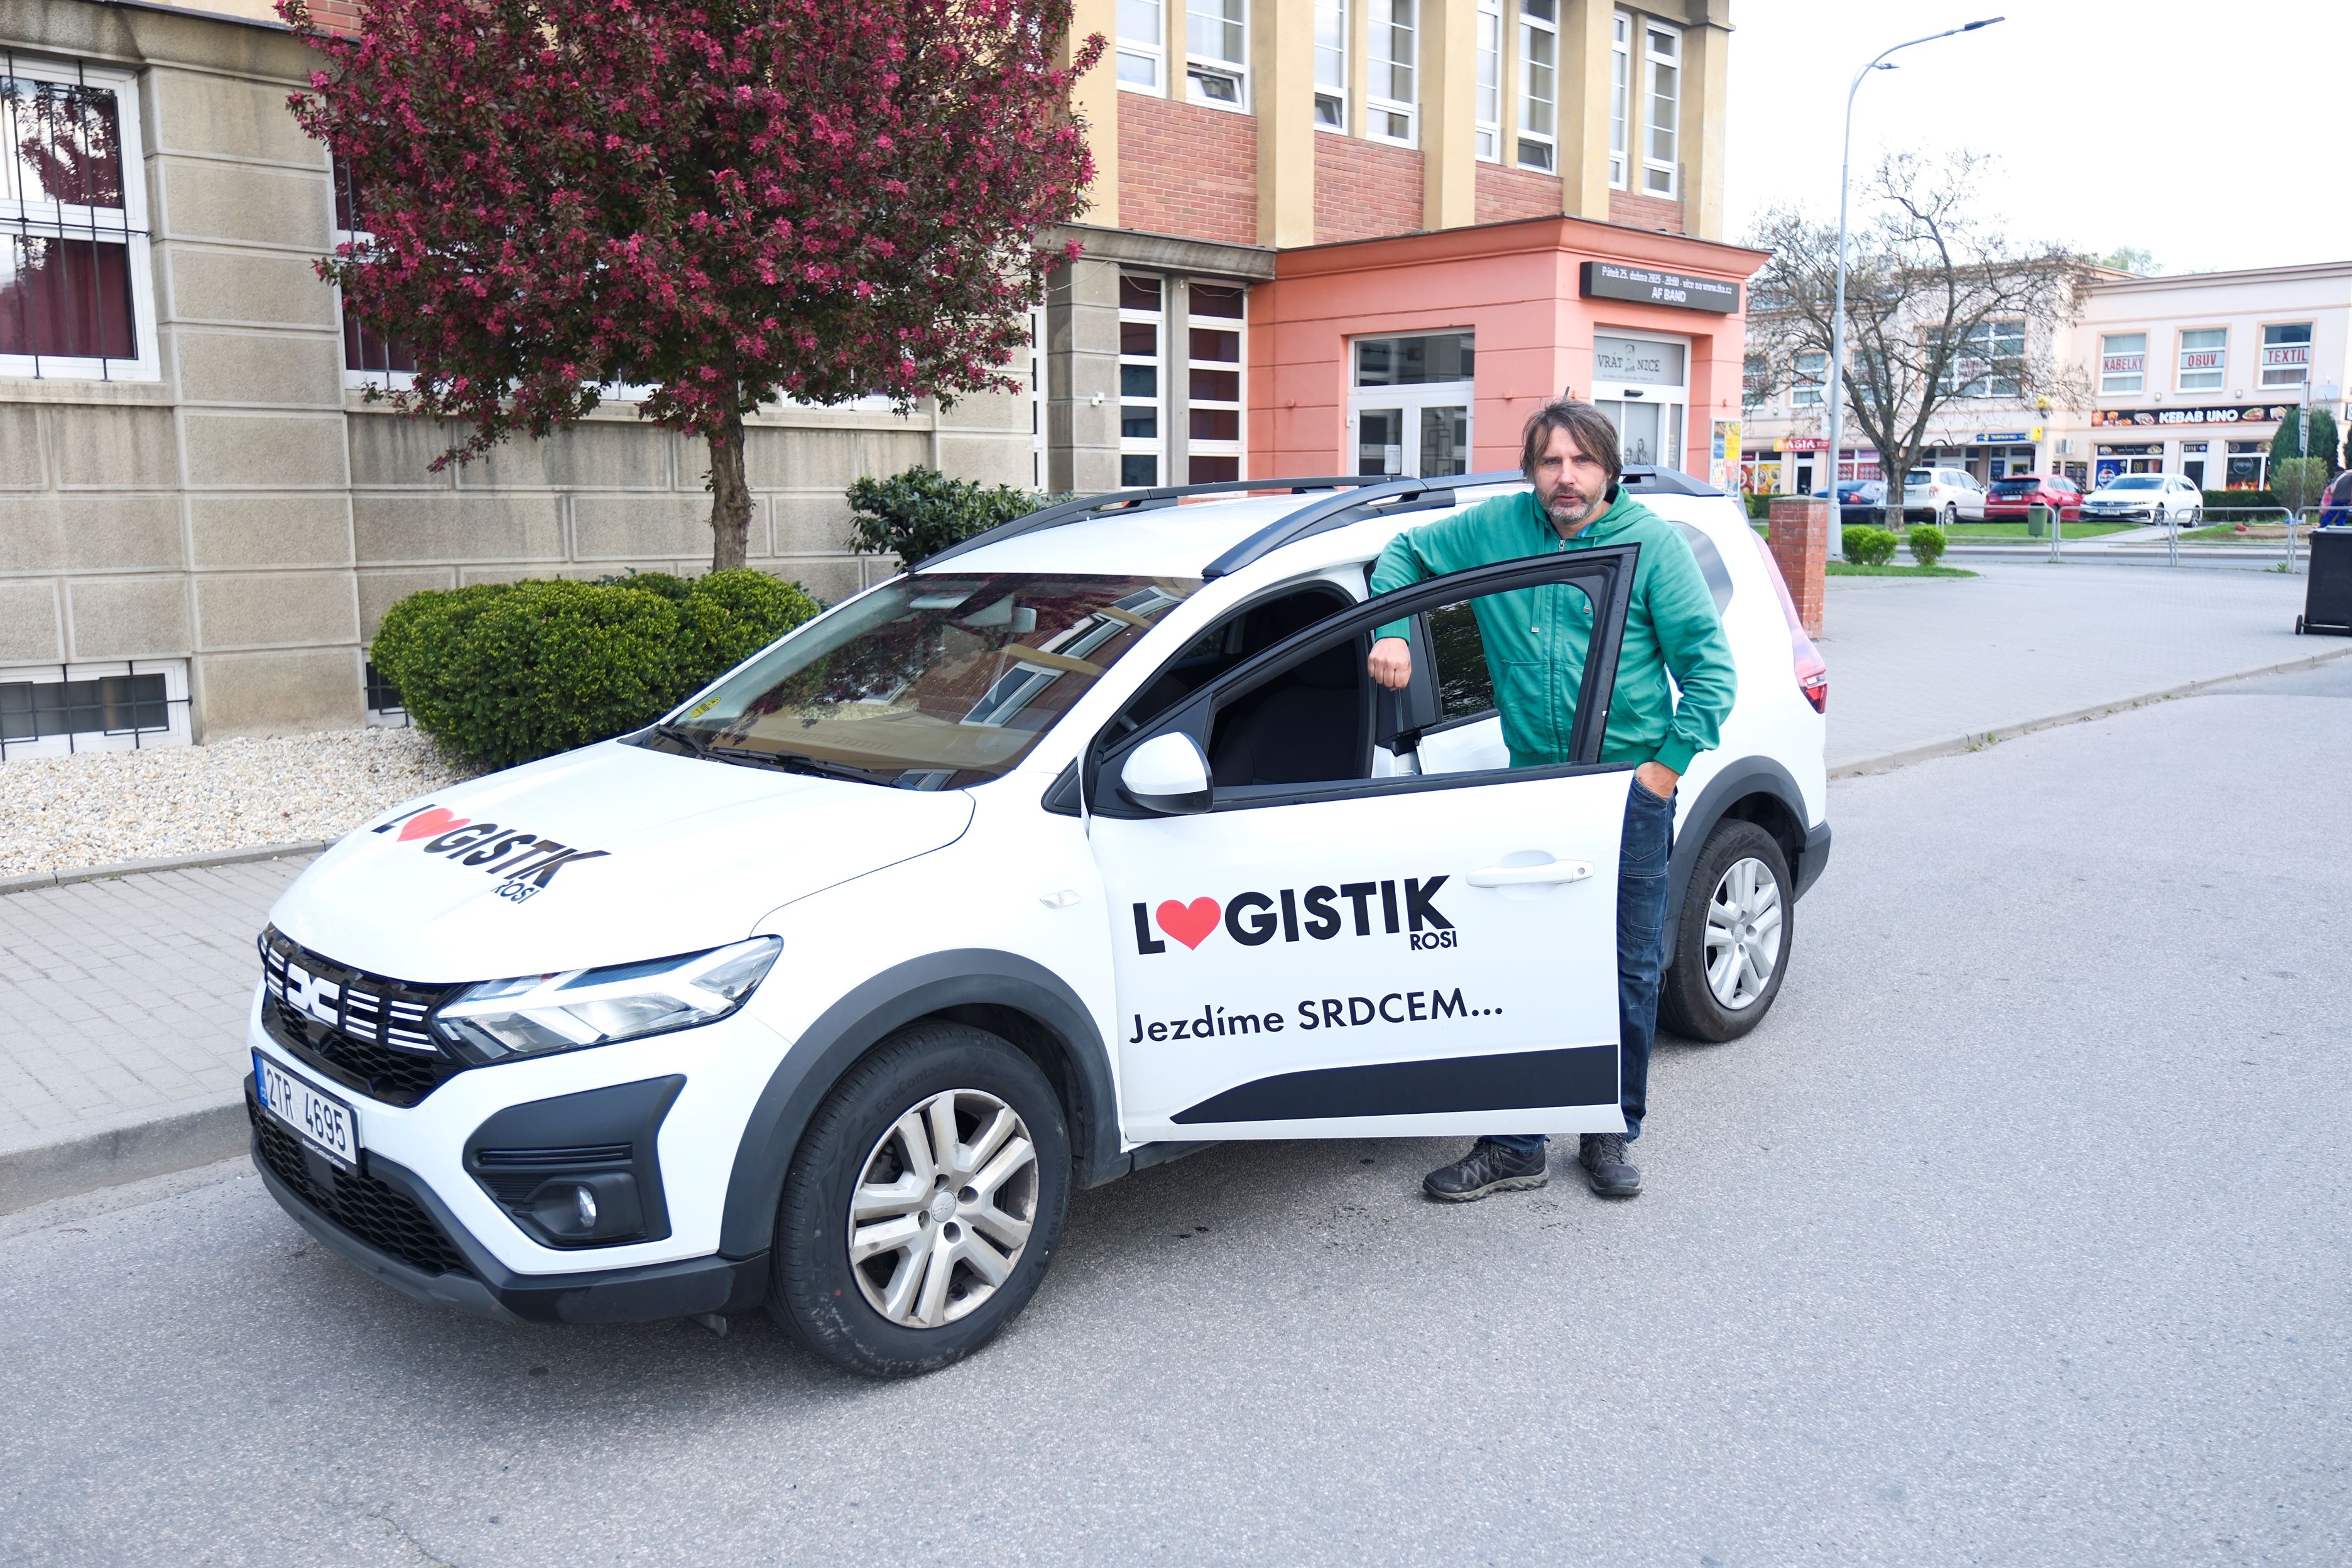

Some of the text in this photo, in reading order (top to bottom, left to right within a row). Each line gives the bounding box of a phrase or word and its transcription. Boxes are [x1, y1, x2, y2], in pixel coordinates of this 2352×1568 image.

[1651, 286, 1686, 302] AF BAND
[1598, 352, 1660, 372] VRÁT NICE
[2103, 357, 2144, 371] KABELKY
[2187, 354, 2217, 367] OBUV
[2268, 349, 2307, 362] TEXTIL
[2159, 409, 2238, 423] KEBAB UNO
[491, 879, 541, 905] ROSI
[1410, 930, 1457, 950] ROSI
[1129, 988, 1503, 1044] Jezdíme SRDCEM...
[875, 1060, 950, 1115] EcoContact
[267, 1068, 346, 1151] 2TR 4695
